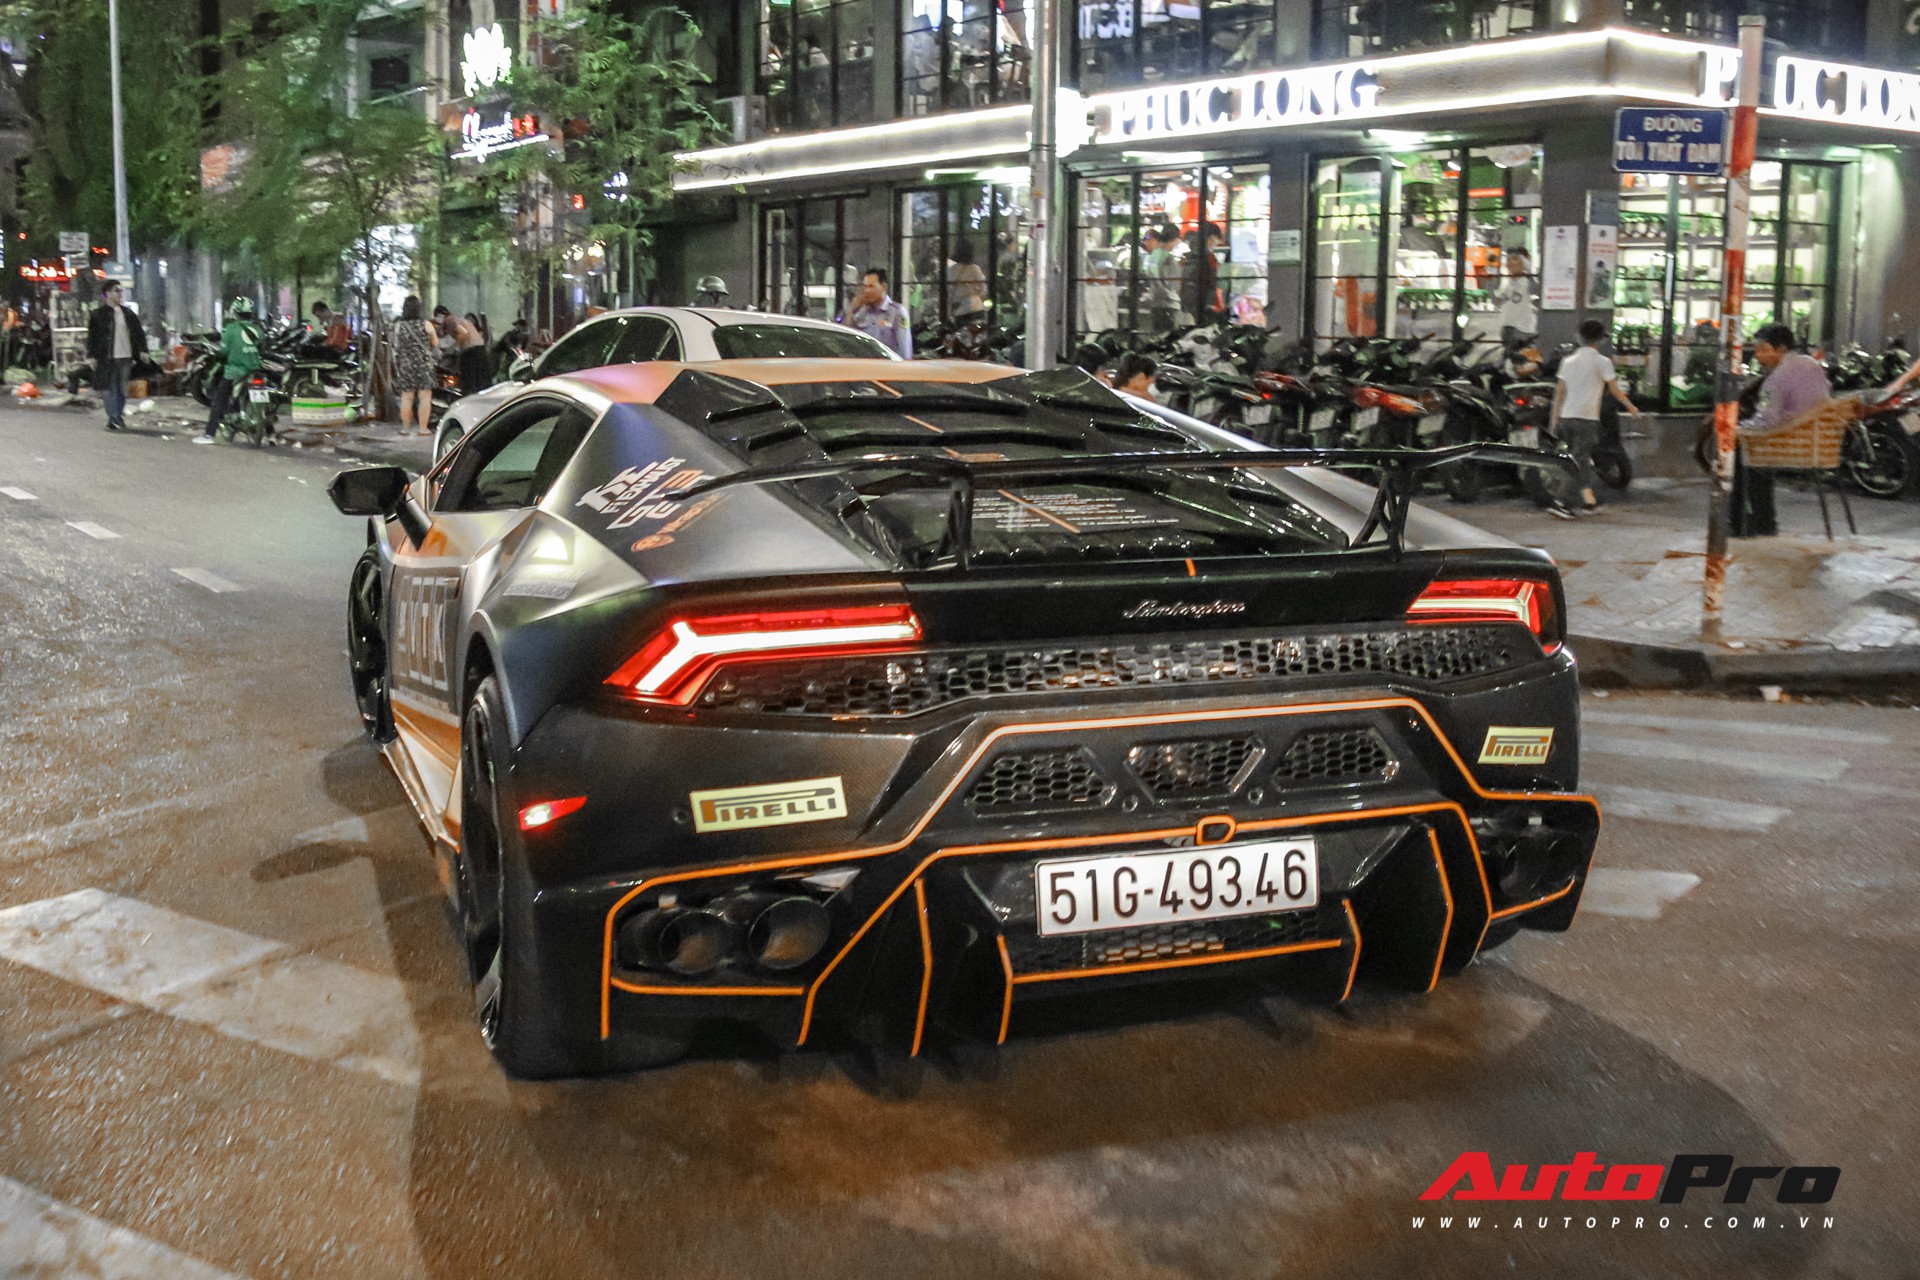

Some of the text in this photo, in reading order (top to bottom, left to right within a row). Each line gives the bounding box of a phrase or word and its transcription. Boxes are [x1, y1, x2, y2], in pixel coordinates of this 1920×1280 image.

[1241, 64, 1378, 124] LONG
[1484, 735, 1549, 757] PIRELLI
[699, 787, 837, 824] PIRELLI
[1050, 849, 1307, 925] 51G-493.46
